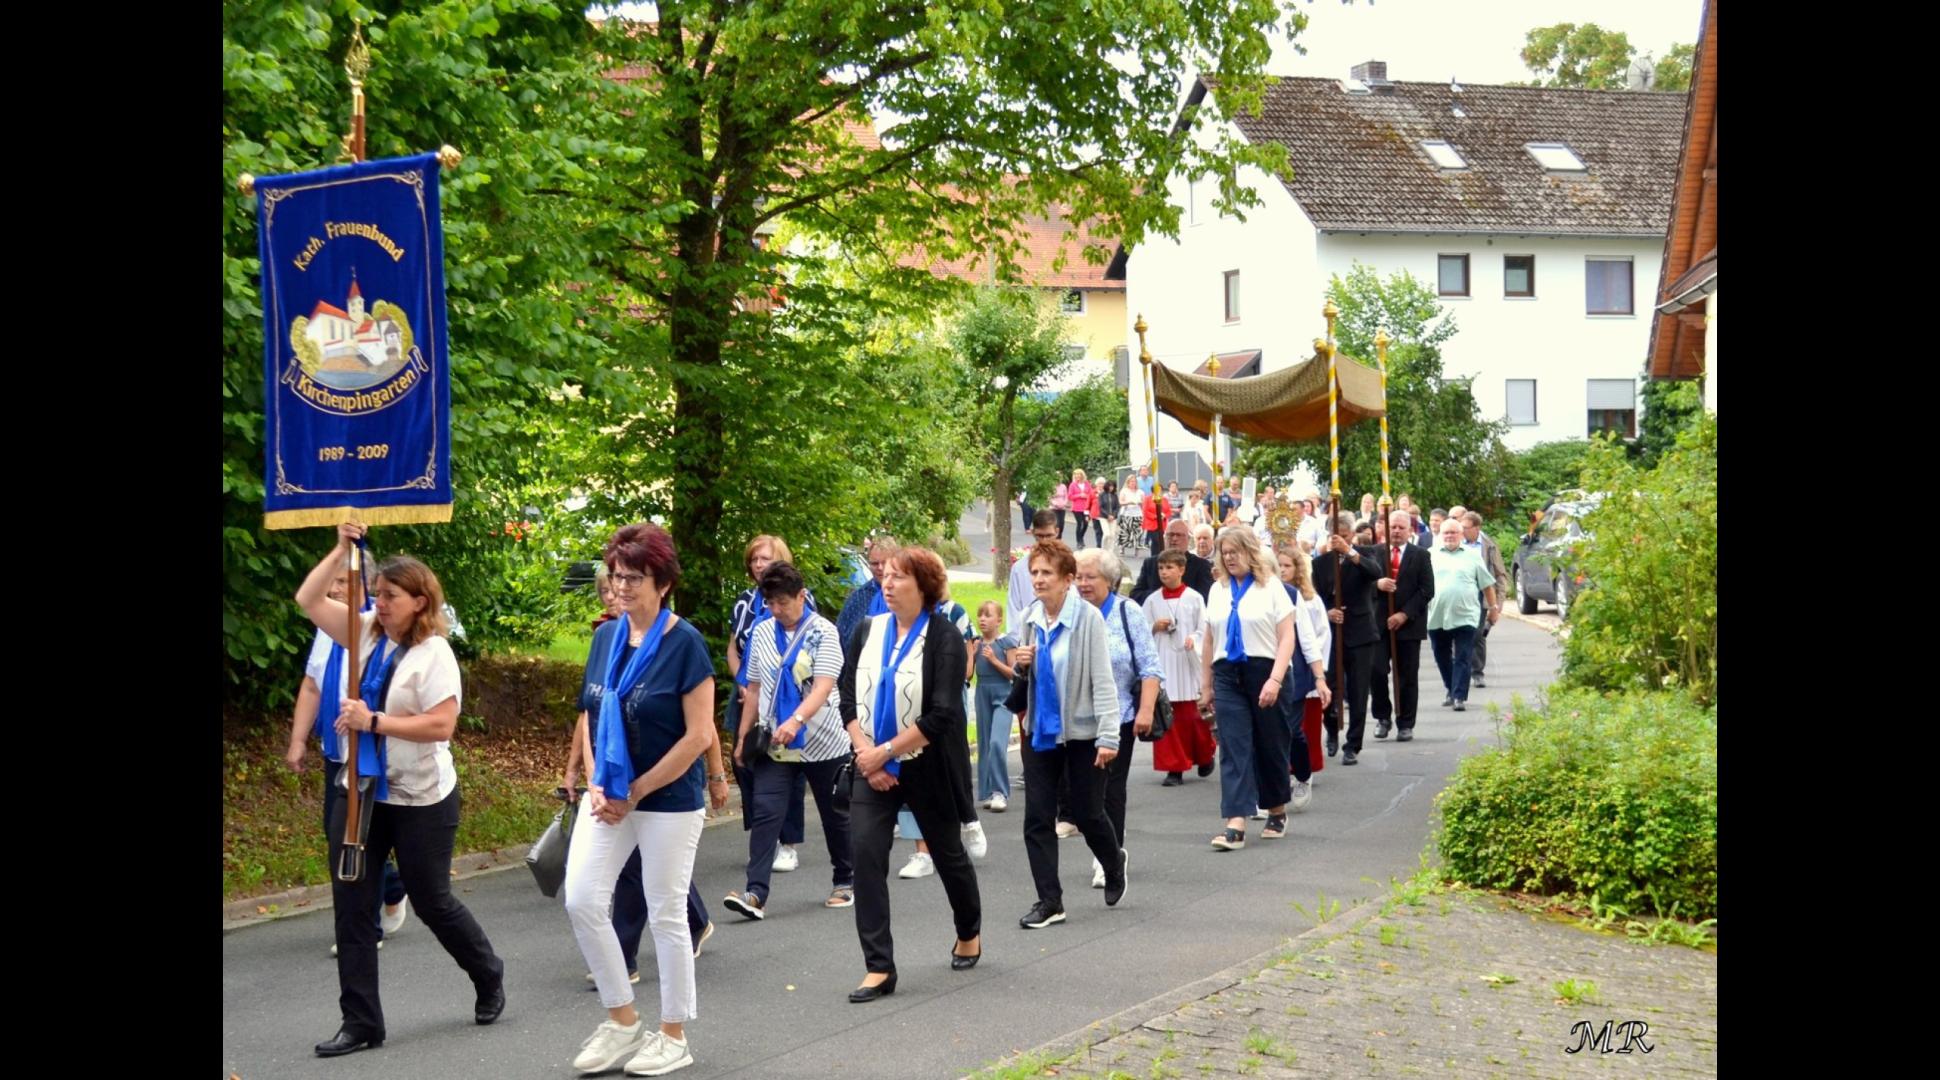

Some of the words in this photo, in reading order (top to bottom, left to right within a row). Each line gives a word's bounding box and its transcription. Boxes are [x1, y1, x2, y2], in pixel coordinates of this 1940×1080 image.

[293, 236, 326, 272] Kath.
[324, 221, 405, 262] Frauenbund
[297, 369, 417, 412] Kirchenpingarten
[319, 446, 346, 462] 1989
[357, 443, 390, 460] 2009
